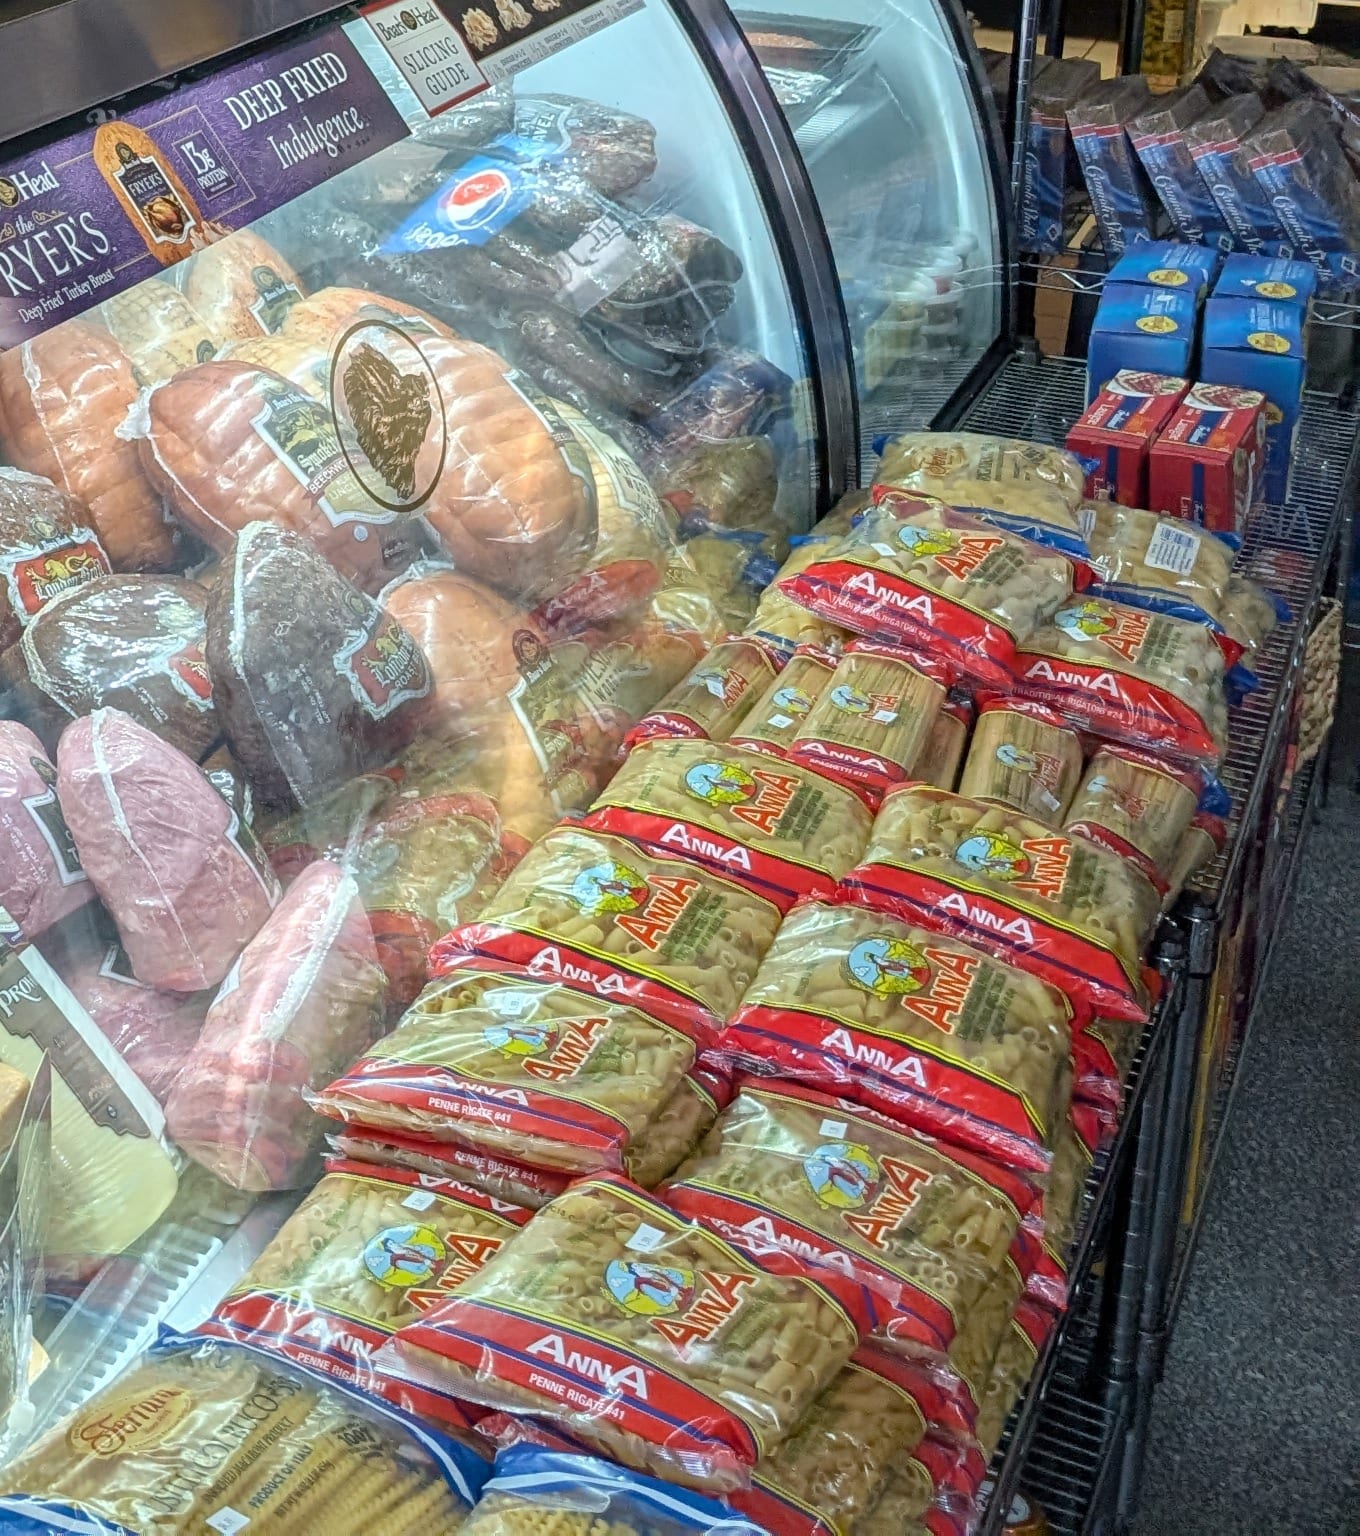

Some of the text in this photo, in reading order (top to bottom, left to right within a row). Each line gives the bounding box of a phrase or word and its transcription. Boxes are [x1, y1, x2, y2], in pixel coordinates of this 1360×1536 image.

[376, 1, 440, 42] Boar's Head
[403, 36, 459, 74] SLICING
[426, 62, 470, 96] GUIDE
[224, 51, 349, 133] DEEP FRIED
[10, 160, 60, 201] Head
[181, 140, 216, 176] 13g
[197, 166, 228, 190] PROTEIN
[128, 172, 164, 196] FRYER'S
[15, 215, 35, 234] the
[18, 268, 116, 324] Deep Fried Turkey Breast
[933, 535, 1005, 583] ANNA
[35, 577, 78, 601] London
[847, 572, 936, 621] ANNA
[1097, 608, 1151, 662] ANNA
[1025, 659, 1120, 698] ANNA
[800, 741, 886, 774] ANNA
[810, 758, 847, 775] SPAGHETTI
[730, 768, 801, 834] ANNA
[660, 825, 753, 871] ANNA
[613, 874, 699, 953] ANNA
[939, 891, 1035, 944] ANNA
[527, 946, 627, 996] ANNA
[900, 946, 979, 1035] ANNA
[521, 1016, 612, 1083] ANNA
[822, 1027, 928, 1088] ANNA
[428, 1095, 511, 1124] PENNE RIGATE #41
[454, 1150, 539, 1183] PENNE RIGATE #41
[839, 1155, 936, 1248] ANNA
[742, 1215, 853, 1277] ANNA
[647, 1268, 758, 1361] ANNA
[297, 1351, 335, 1374] PENNE
[335, 1362, 370, 1388] RIGATE
[525, 1333, 649, 1401] ANNA
[529, 1371, 626, 1421] PENNE RIGATE #41
[249, 1472, 284, 1510] PRODUCT
[292, 1444, 314, 1470] ITALY
